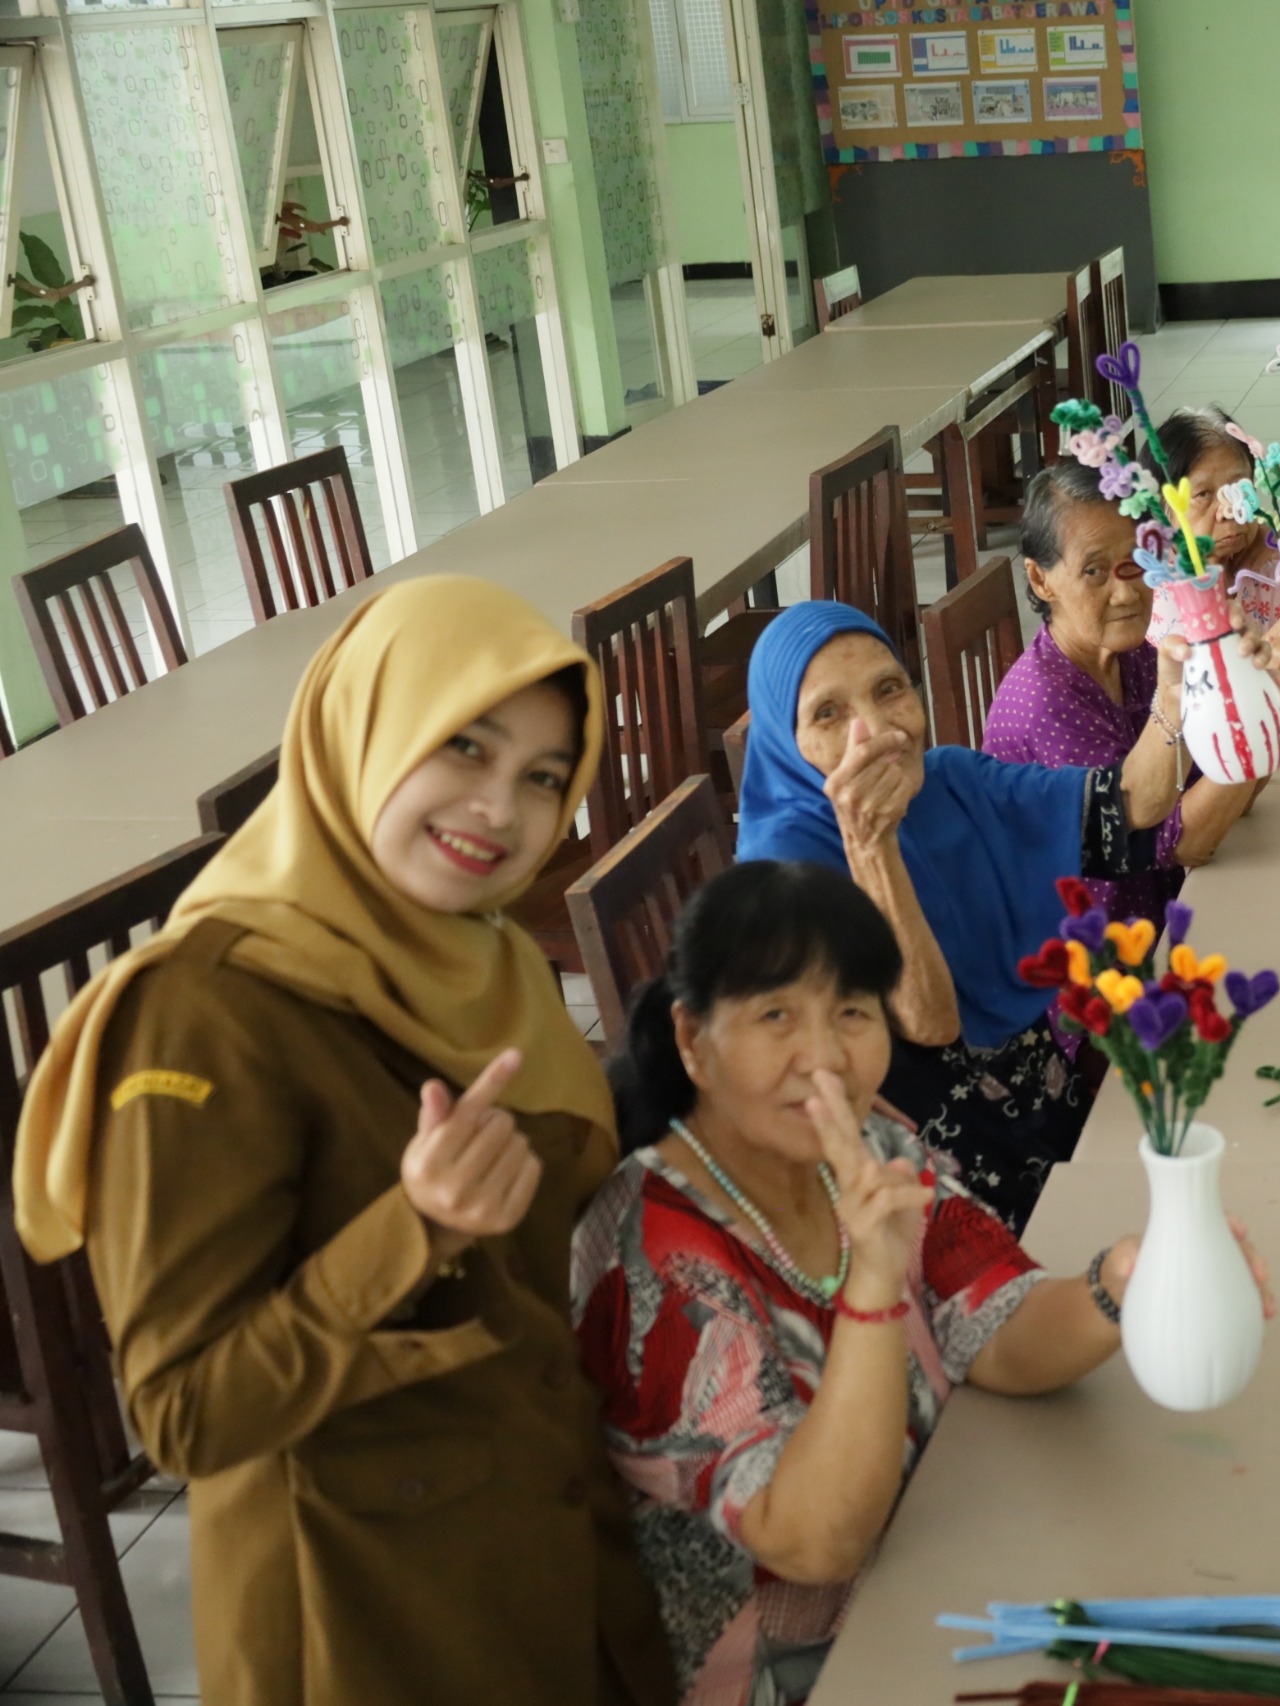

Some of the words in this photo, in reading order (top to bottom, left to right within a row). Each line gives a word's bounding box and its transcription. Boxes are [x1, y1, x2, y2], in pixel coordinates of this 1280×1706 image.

[911, 8, 969, 24] KUSTA
[970, 4, 1023, 20] BABAT
[1026, 0, 1108, 18] JERAWAT
